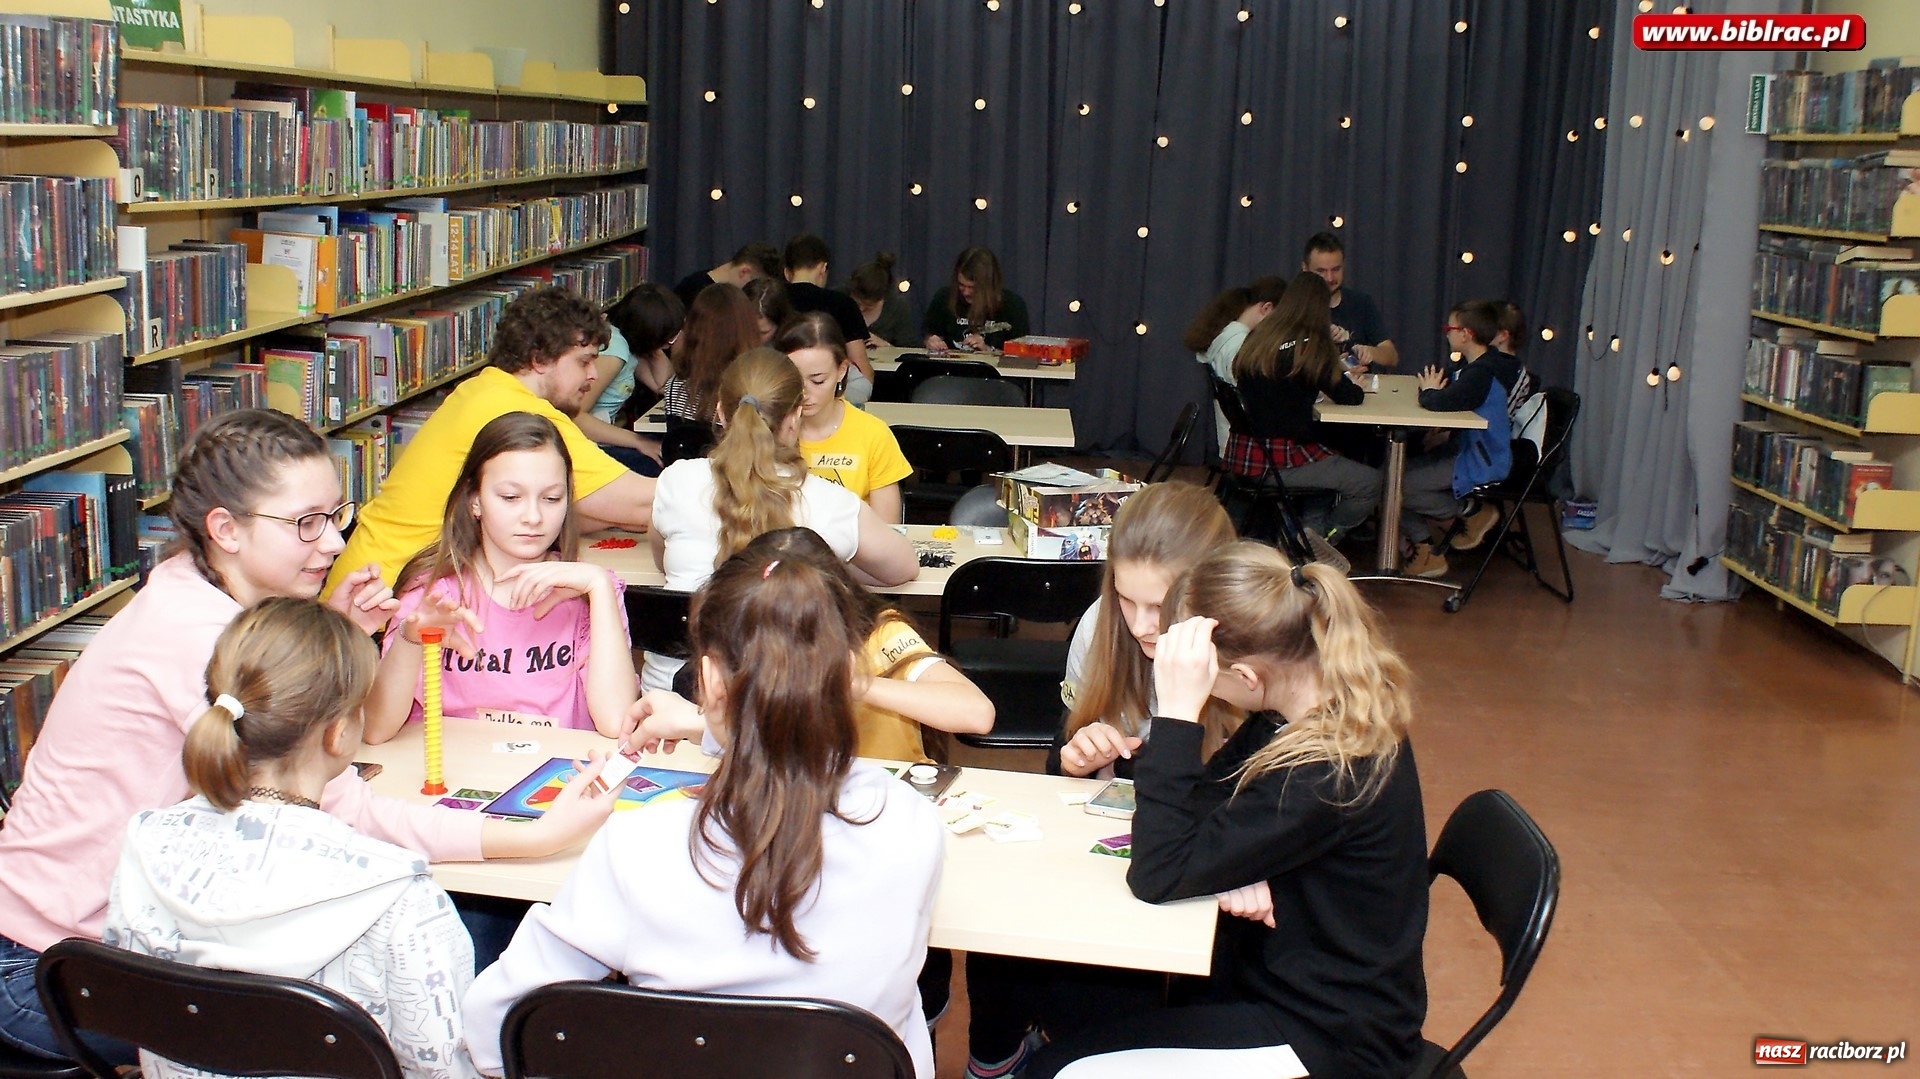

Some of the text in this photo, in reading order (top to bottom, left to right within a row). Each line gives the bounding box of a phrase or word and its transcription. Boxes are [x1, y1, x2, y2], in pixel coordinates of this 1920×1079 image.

[209, 173, 216, 196] P
[328, 172, 334, 192] D
[450, 222, 459, 275] 12-14 LAT
[151, 324, 159, 349] R
[817, 454, 853, 466] Aneta
[441, 646, 513, 675] Total
